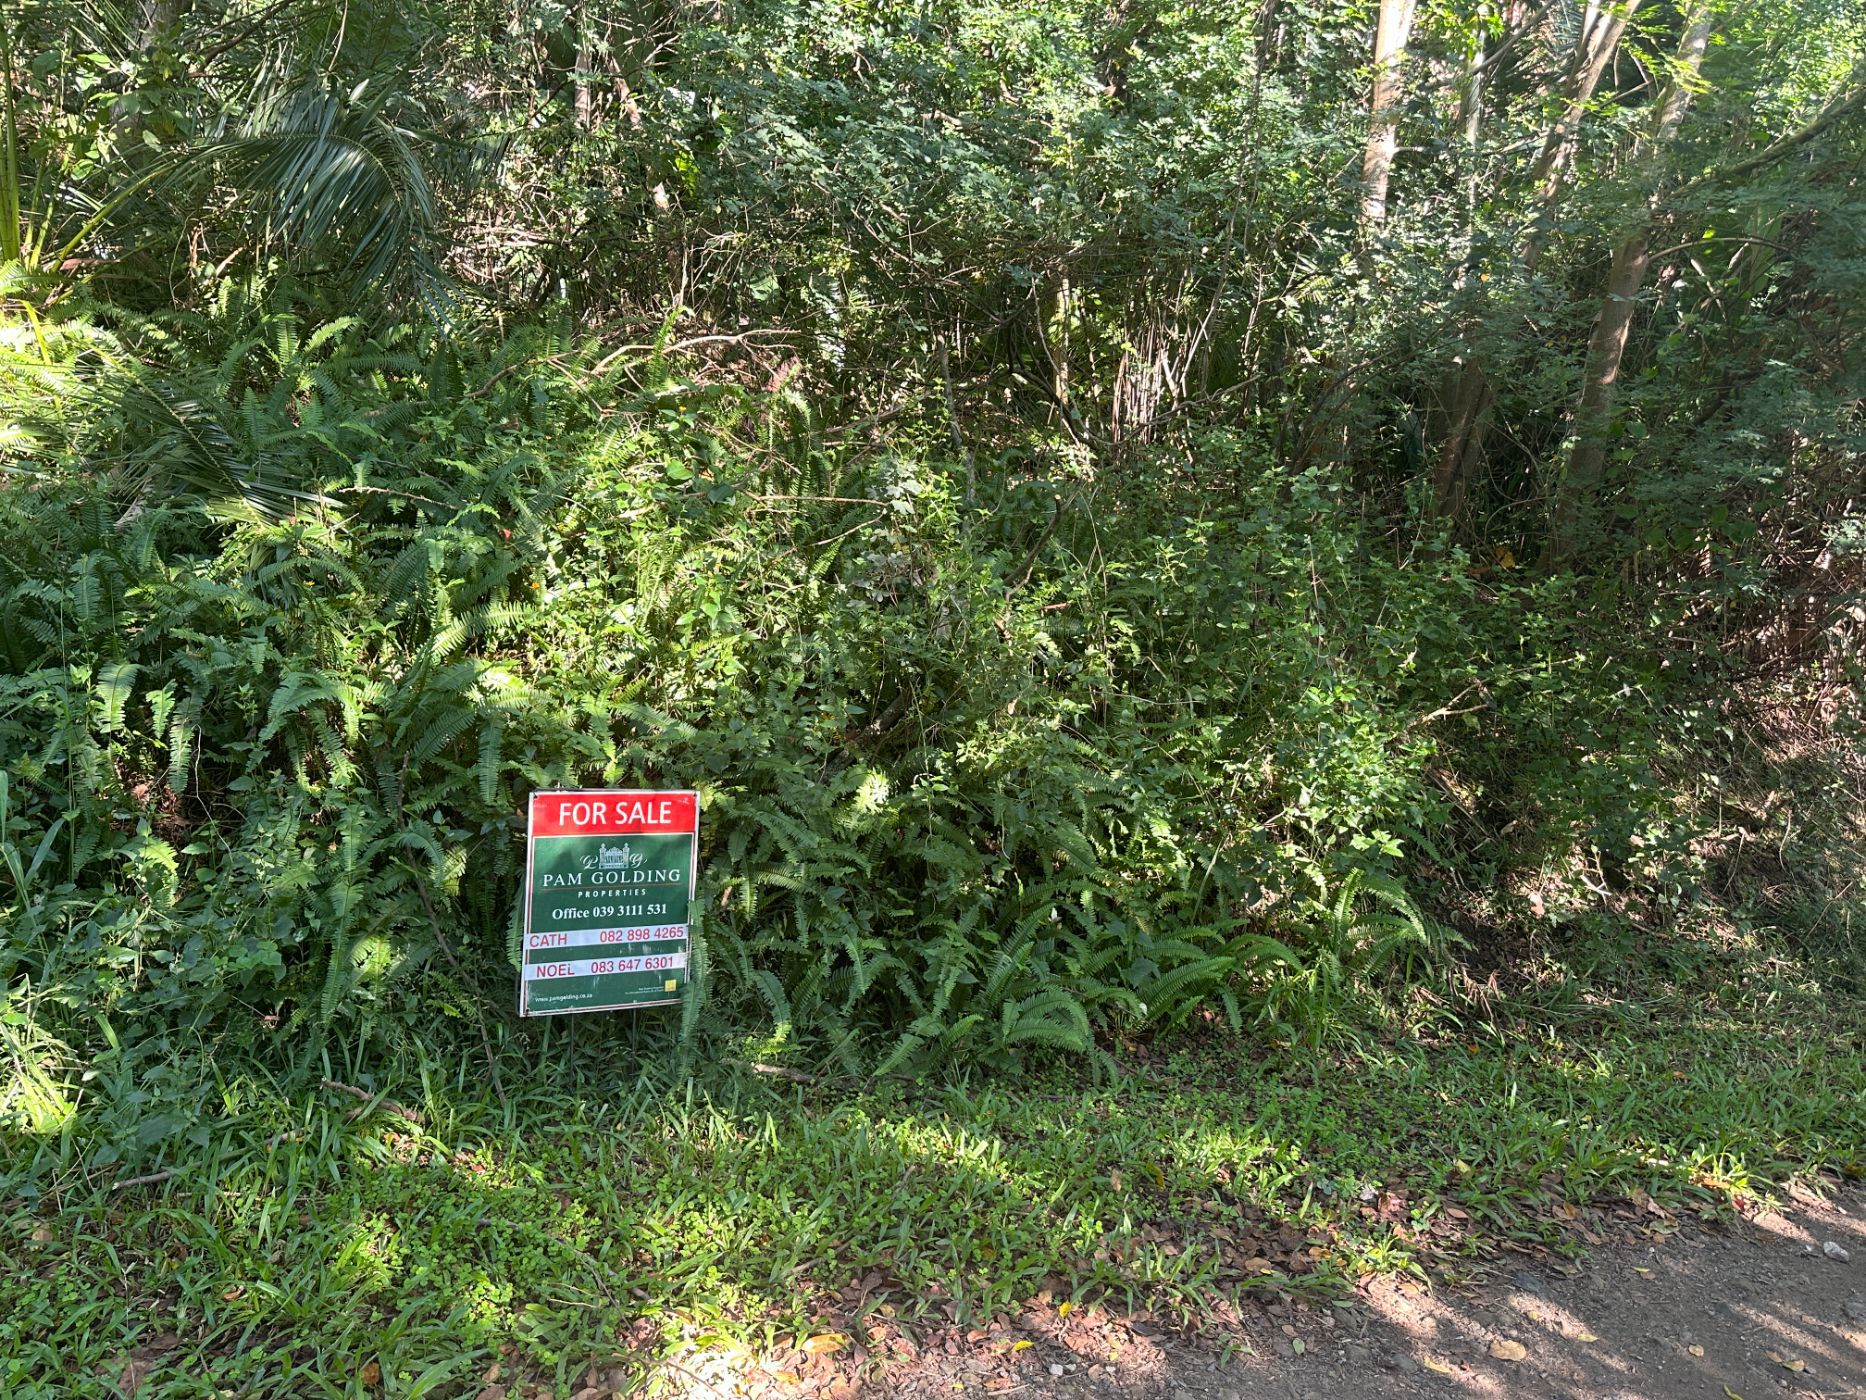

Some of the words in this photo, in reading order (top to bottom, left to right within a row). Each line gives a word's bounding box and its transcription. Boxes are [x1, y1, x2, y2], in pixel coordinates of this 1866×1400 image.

[559, 801, 607, 826] FOR
[615, 801, 672, 825] SALE
[543, 872, 583, 887] PAM
[591, 869, 681, 885] GOLDING
[578, 888, 647, 899] PROPERTIES
[552, 906, 590, 920] Office
[592, 904, 615, 918] 039
[618, 904, 643, 917] 3111
[647, 903, 667, 915] 531
[529, 932, 568, 948] CATH
[599, 929, 623, 943] 082
[627, 928, 650, 941] 898
[654, 926, 684, 939] 4265
[590, 961, 614, 974] 083
[618, 958, 641, 971] 647
[645, 956, 673, 969] 6301
